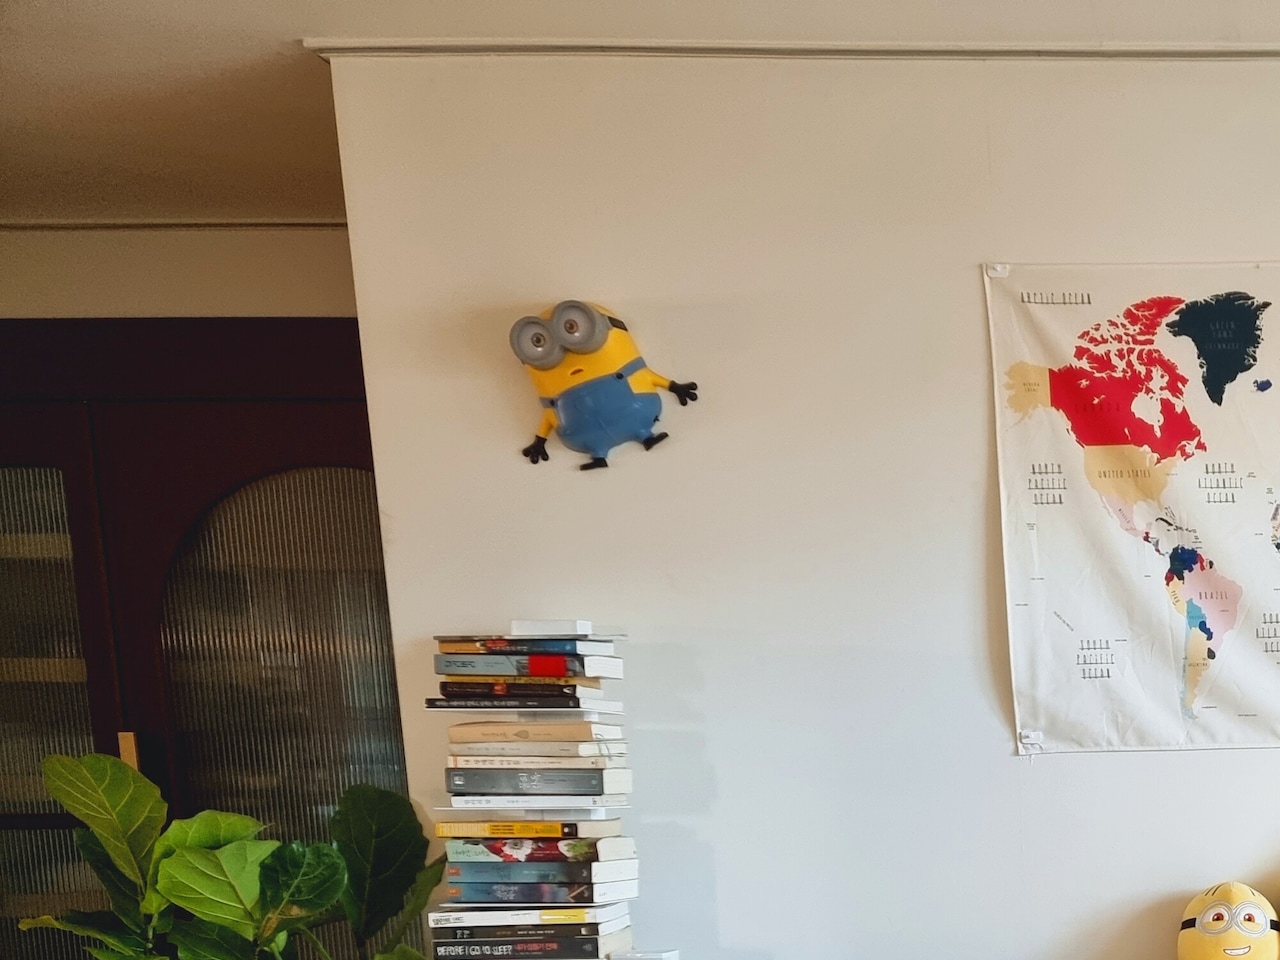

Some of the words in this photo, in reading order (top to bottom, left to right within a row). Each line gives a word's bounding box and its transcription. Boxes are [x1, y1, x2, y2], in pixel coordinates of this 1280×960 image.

[1062, 292, 1092, 305] OCEAN
[1030, 463, 1063, 475] NORTH
[1097, 468, 1126, 479] UNITED
[1129, 468, 1152, 479] STATES
[1204, 463, 1236, 474] NORTH
[1032, 493, 1064, 505] OCEAN
[1206, 492, 1236, 503] OCEAN
[1198, 591, 1230, 601] BRAZIL
[1080, 639, 1111, 650] SOUTH
[1081, 668, 1112, 679] OCEAN
[436, 945, 466, 957] BEFORE
[469, 945, 482, 956] GO
[482, 945, 491, 955] TO
[492, 944, 512, 955] SLEEP
